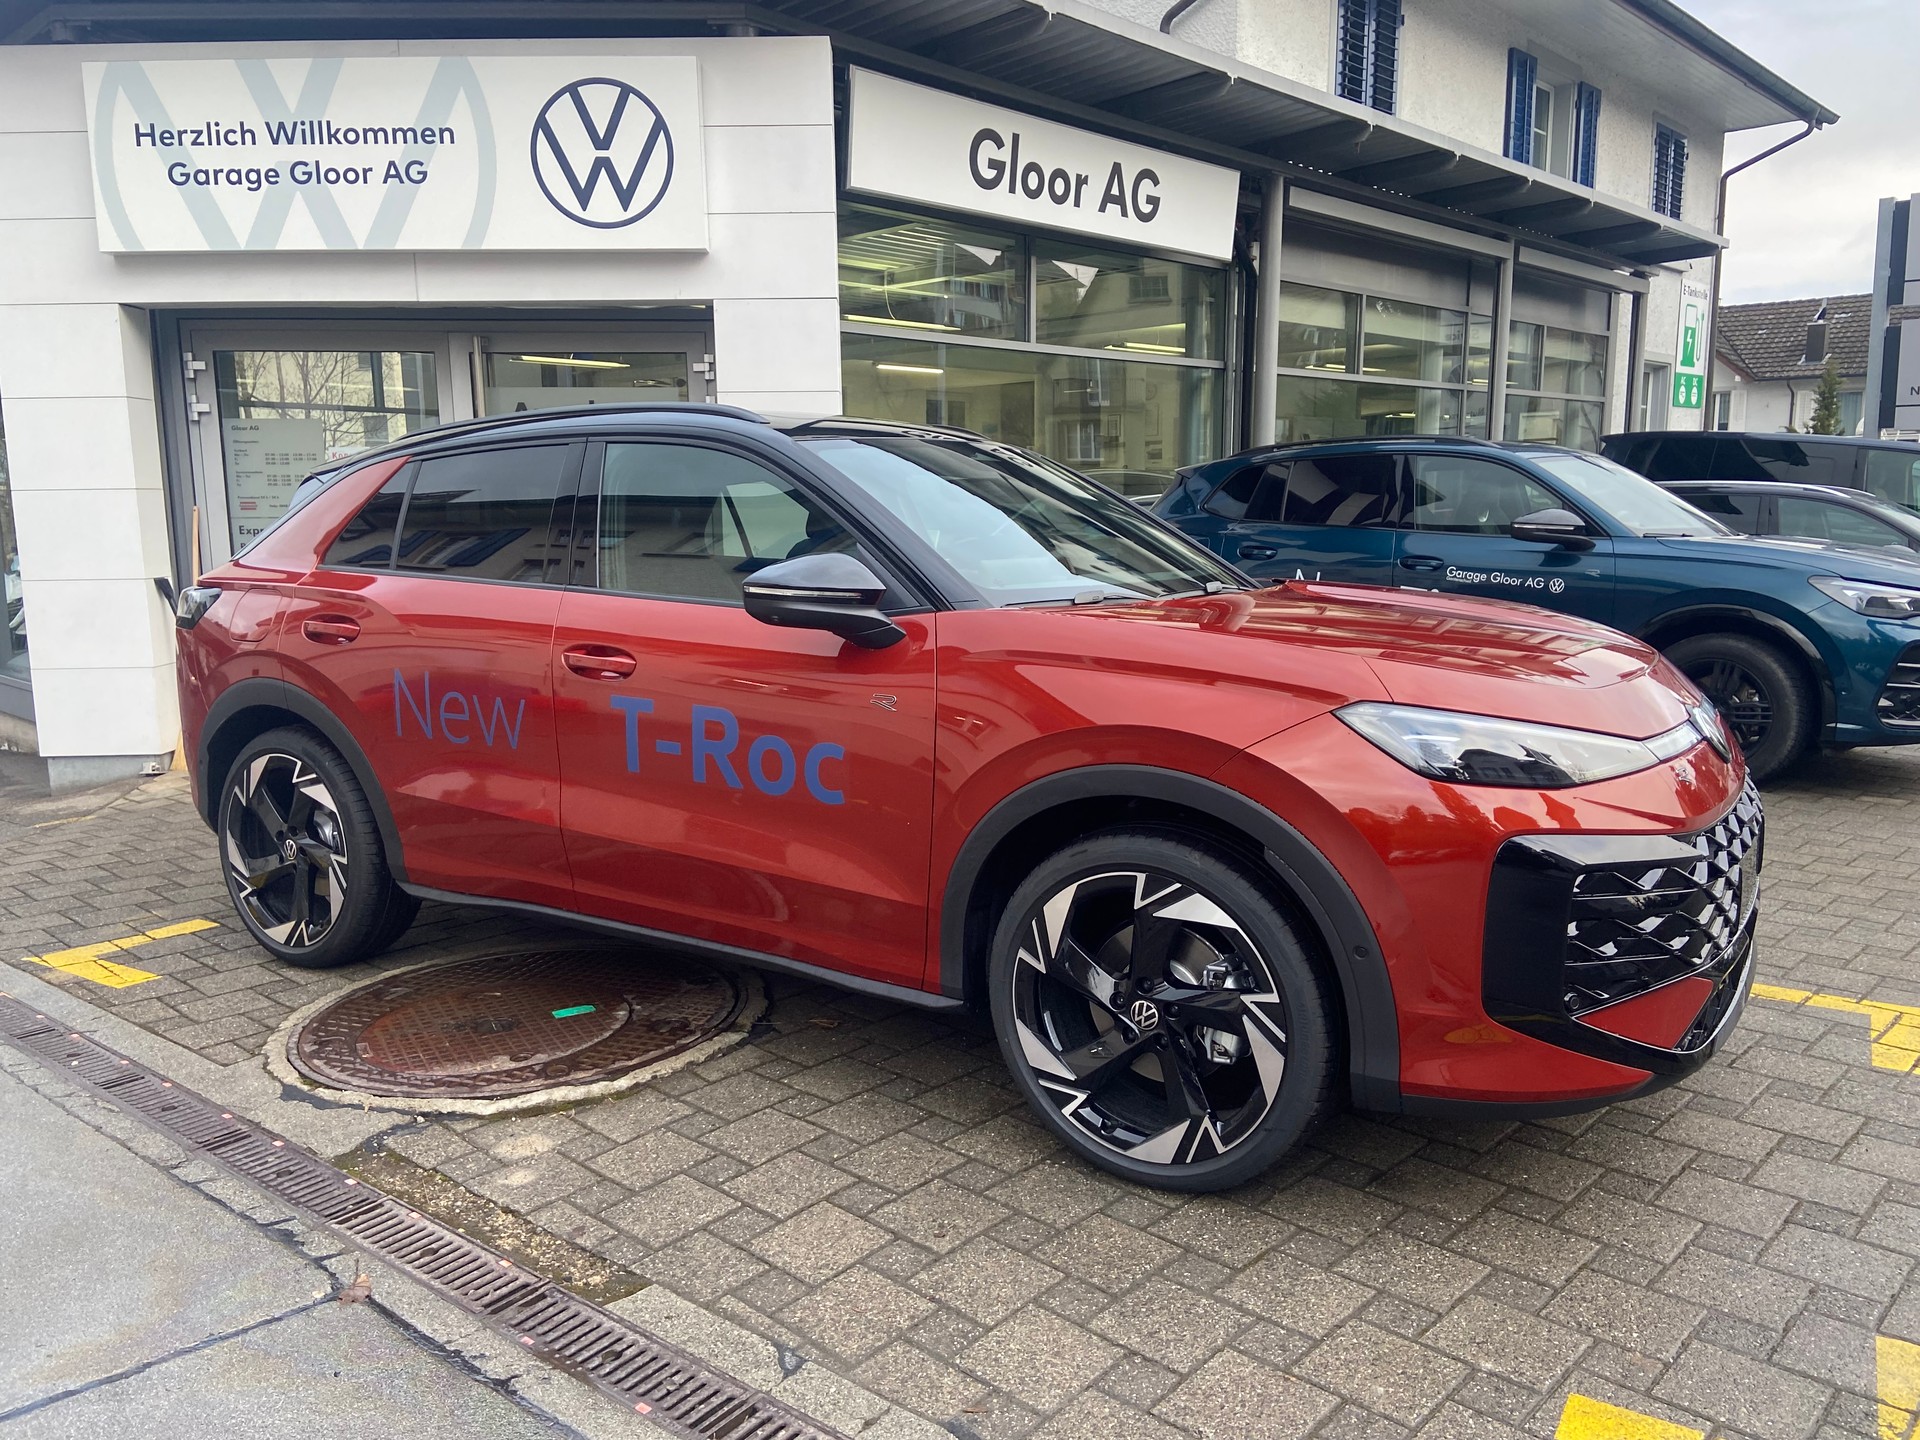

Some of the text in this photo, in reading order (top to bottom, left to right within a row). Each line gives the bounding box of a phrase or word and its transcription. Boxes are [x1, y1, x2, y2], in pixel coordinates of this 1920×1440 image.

[134, 120, 456, 147] Herzlich Willkommen
[167, 159, 428, 192] Garage Gloor AG
[969, 127, 1161, 223] Gloor AG
[1446, 566, 1487, 583] Garage
[1490, 571, 1523, 586] Gloor
[1525, 577, 1545, 589] AG
[392, 668, 526, 750] New
[610, 694, 845, 805] T-Roc
